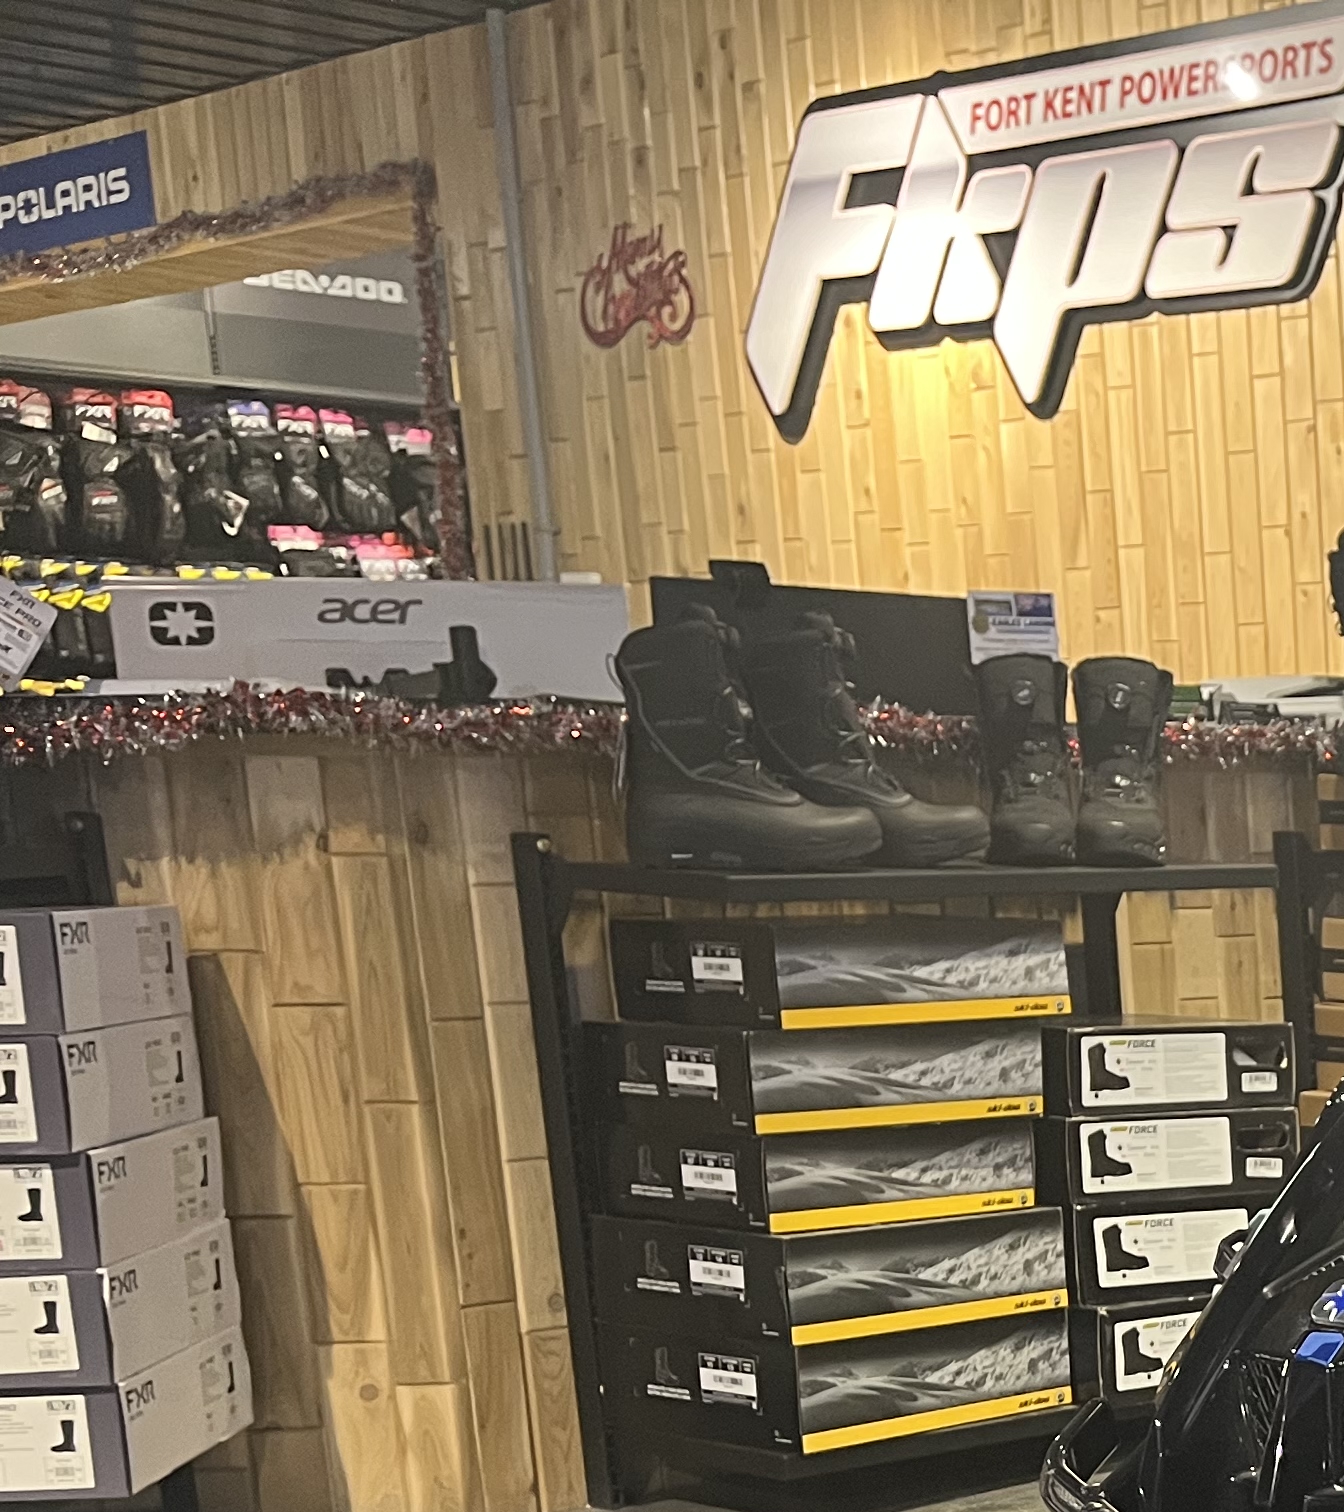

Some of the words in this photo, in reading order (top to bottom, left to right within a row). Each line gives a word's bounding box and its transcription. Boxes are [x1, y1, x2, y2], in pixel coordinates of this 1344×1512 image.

[969, 97, 1036, 136] FORT
[1041, 78, 1113, 123] KENT
[0, 166, 131, 230] POLARIS
[316, 597, 423, 625] acer
[59, 921, 92, 947] FXR
[66, 1040, 98, 1068] FXR
[1127, 1038, 1156, 1049] FORCE
[1128, 1124, 1158, 1135] FORCE
[97, 1155, 127, 1185] FXR
[1144, 1217, 1175, 1229] FORCE
[109, 1268, 139, 1300] FXR
[1160, 1317, 1188, 1330] FORCE
[125, 1379, 156, 1414] FXR
